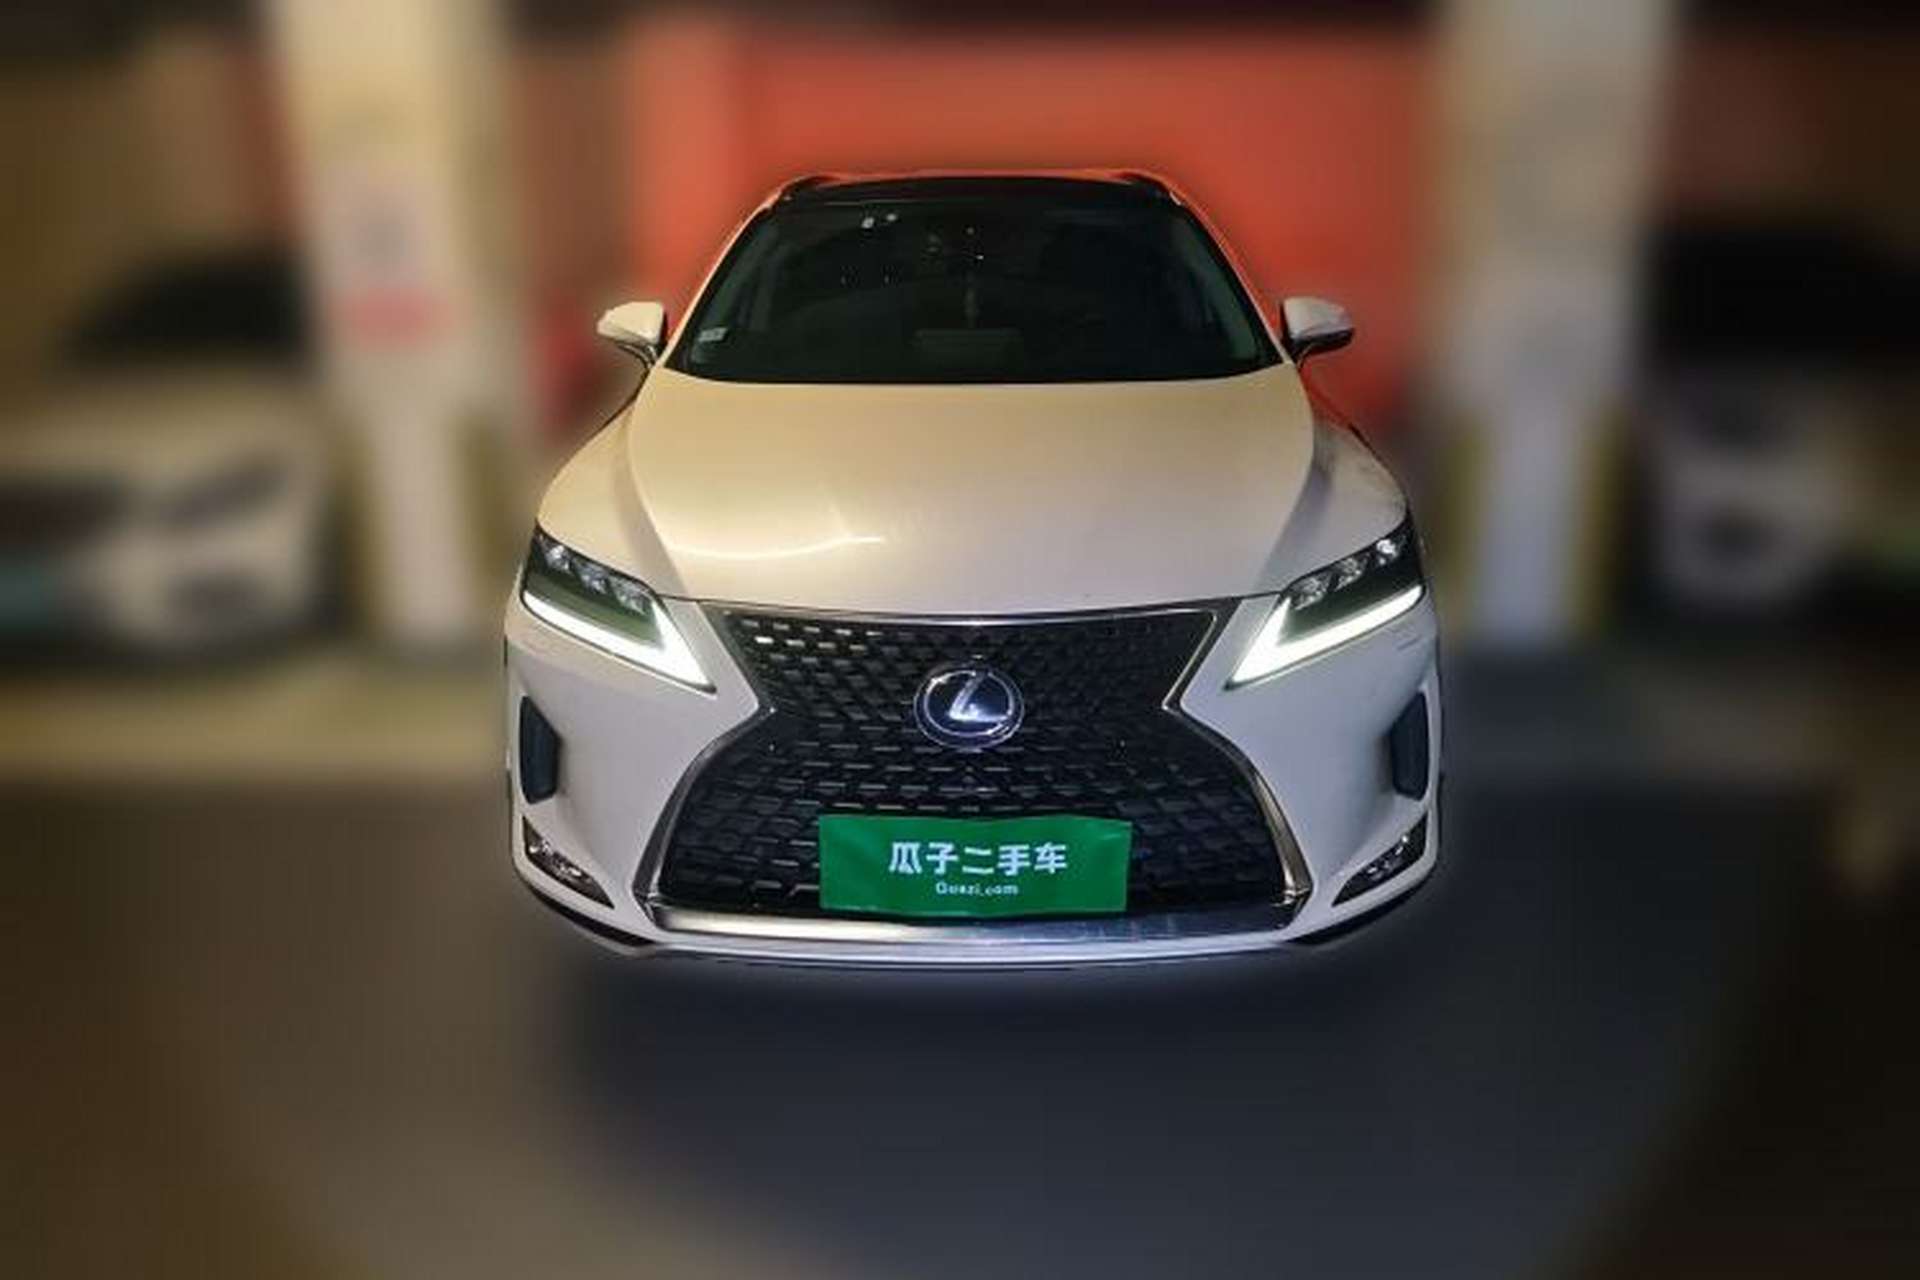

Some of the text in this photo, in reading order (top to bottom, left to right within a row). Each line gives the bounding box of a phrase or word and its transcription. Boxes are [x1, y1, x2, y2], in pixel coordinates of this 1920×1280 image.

[888, 841, 1068, 876] 瓜子二手车
